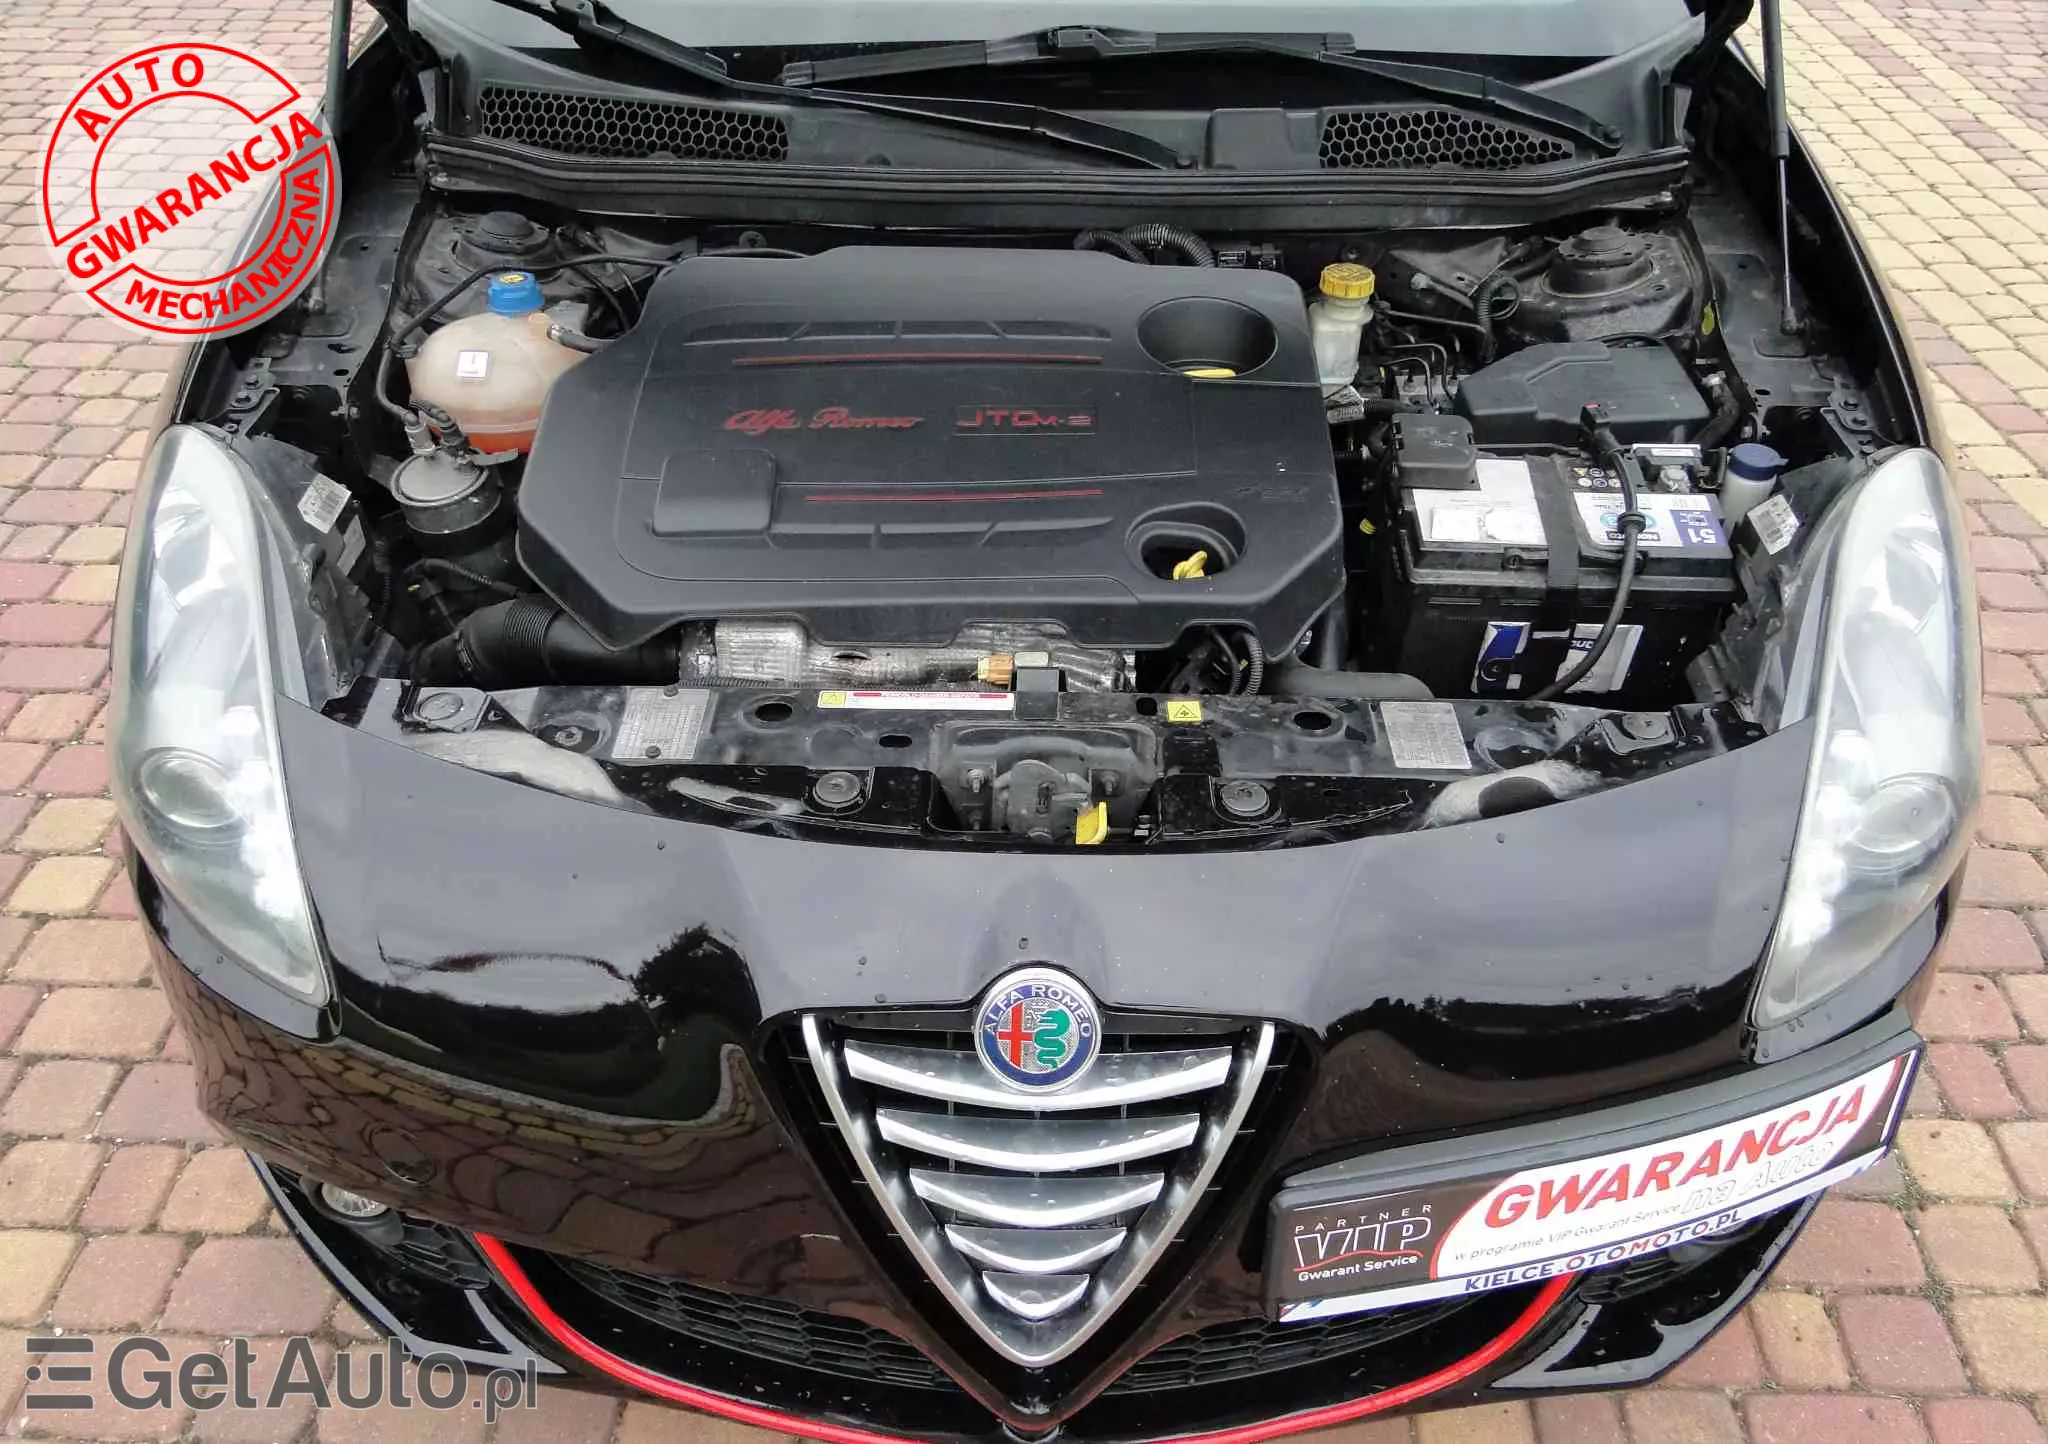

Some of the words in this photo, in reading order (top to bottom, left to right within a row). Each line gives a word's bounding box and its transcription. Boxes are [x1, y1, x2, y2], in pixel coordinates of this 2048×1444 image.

[724, 409, 801, 436] Alfa
[807, 406, 925, 429] Romeo
[1687, 527, 1717, 544] 51
[984, 990, 1025, 1035] ALFA
[1031, 984, 1092, 1038] ROMEO
[1484, 1084, 1866, 1228] GWARANCJA
[1294, 1216, 1432, 1268] VIP
[1295, 1204, 1432, 1234] PARTNER
[1455, 1251, 1468, 1261] w
[1470, 1237, 1544, 1260] programie
[1548, 1229, 1573, 1243] VIP
[1574, 1216, 1632, 1238] Gwarant
[1633, 1203, 1682, 1223] Service
[1298, 1261, 1361, 1281] Gwarant
[1363, 1255, 1419, 1272] Service
[1464, 1208, 1743, 1292] KIELCE.OTOMOTO.PL
